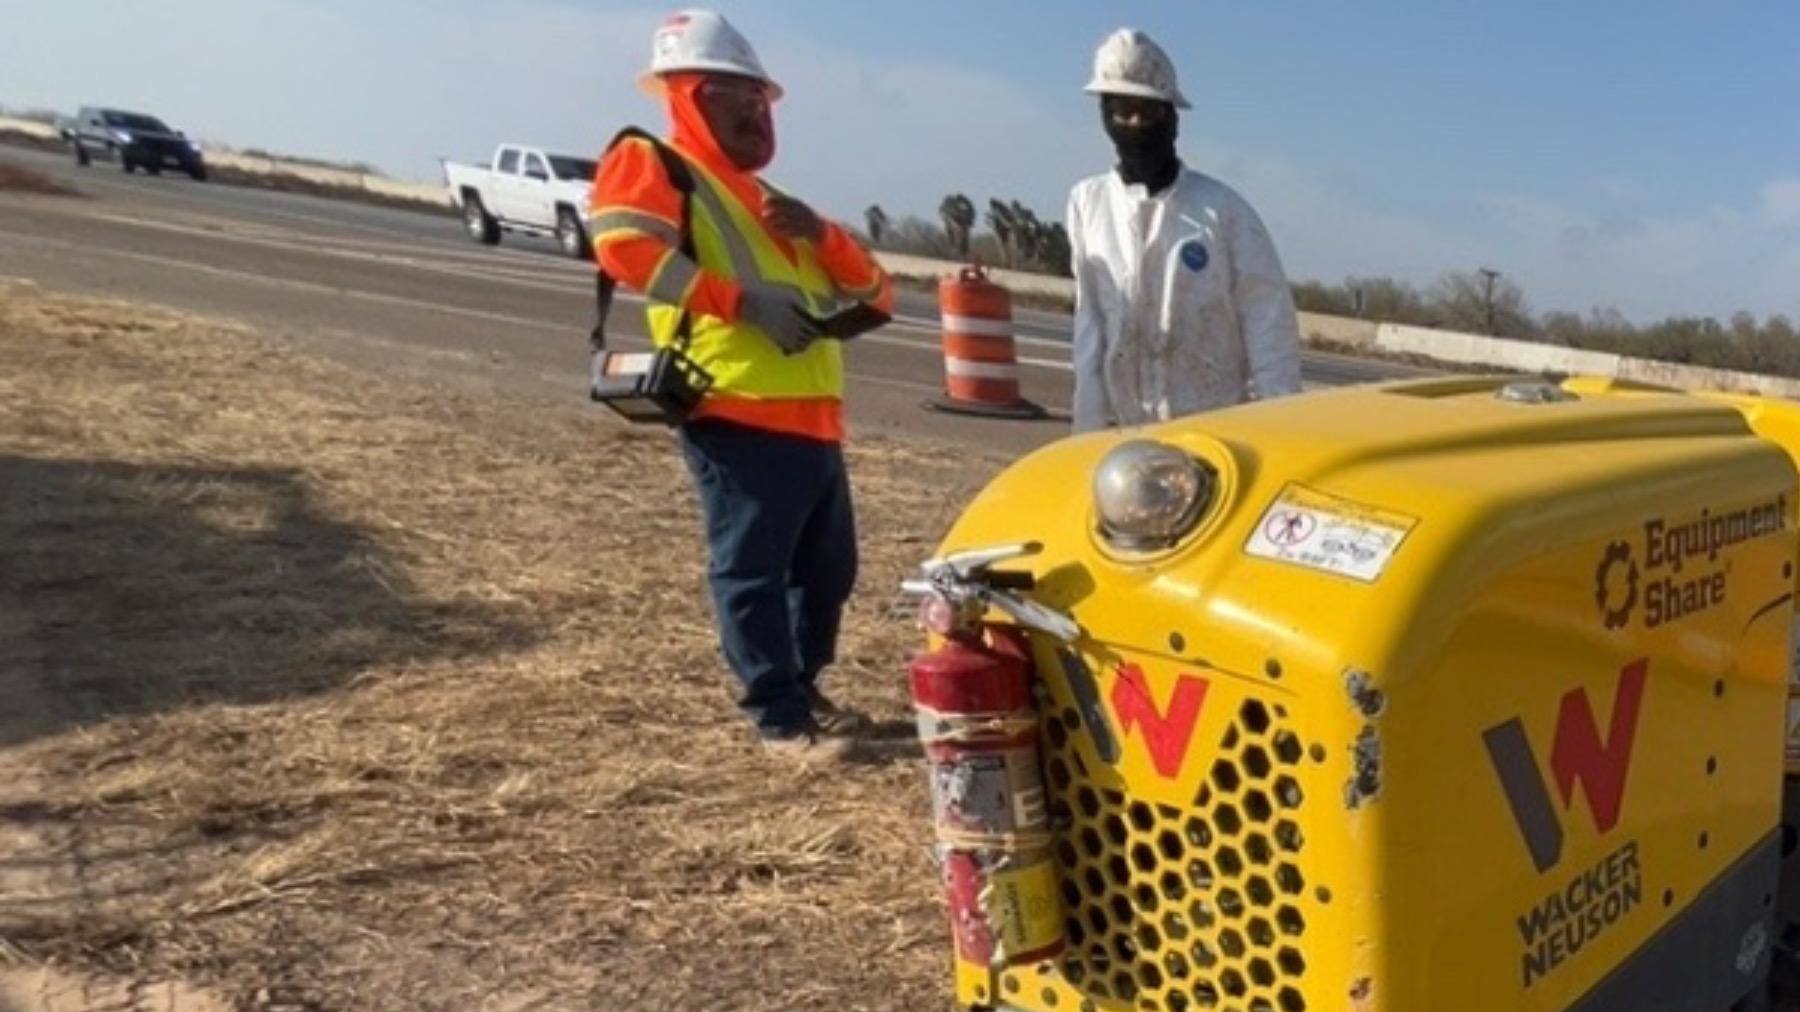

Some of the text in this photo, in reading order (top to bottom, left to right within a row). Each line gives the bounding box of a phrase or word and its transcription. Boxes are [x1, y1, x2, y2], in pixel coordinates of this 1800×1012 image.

[1644, 492, 1787, 574] Equipment
[1644, 571, 1727, 629] Share
[1516, 839, 1640, 946] WACKER
[1522, 871, 1642, 989] NEUSON
